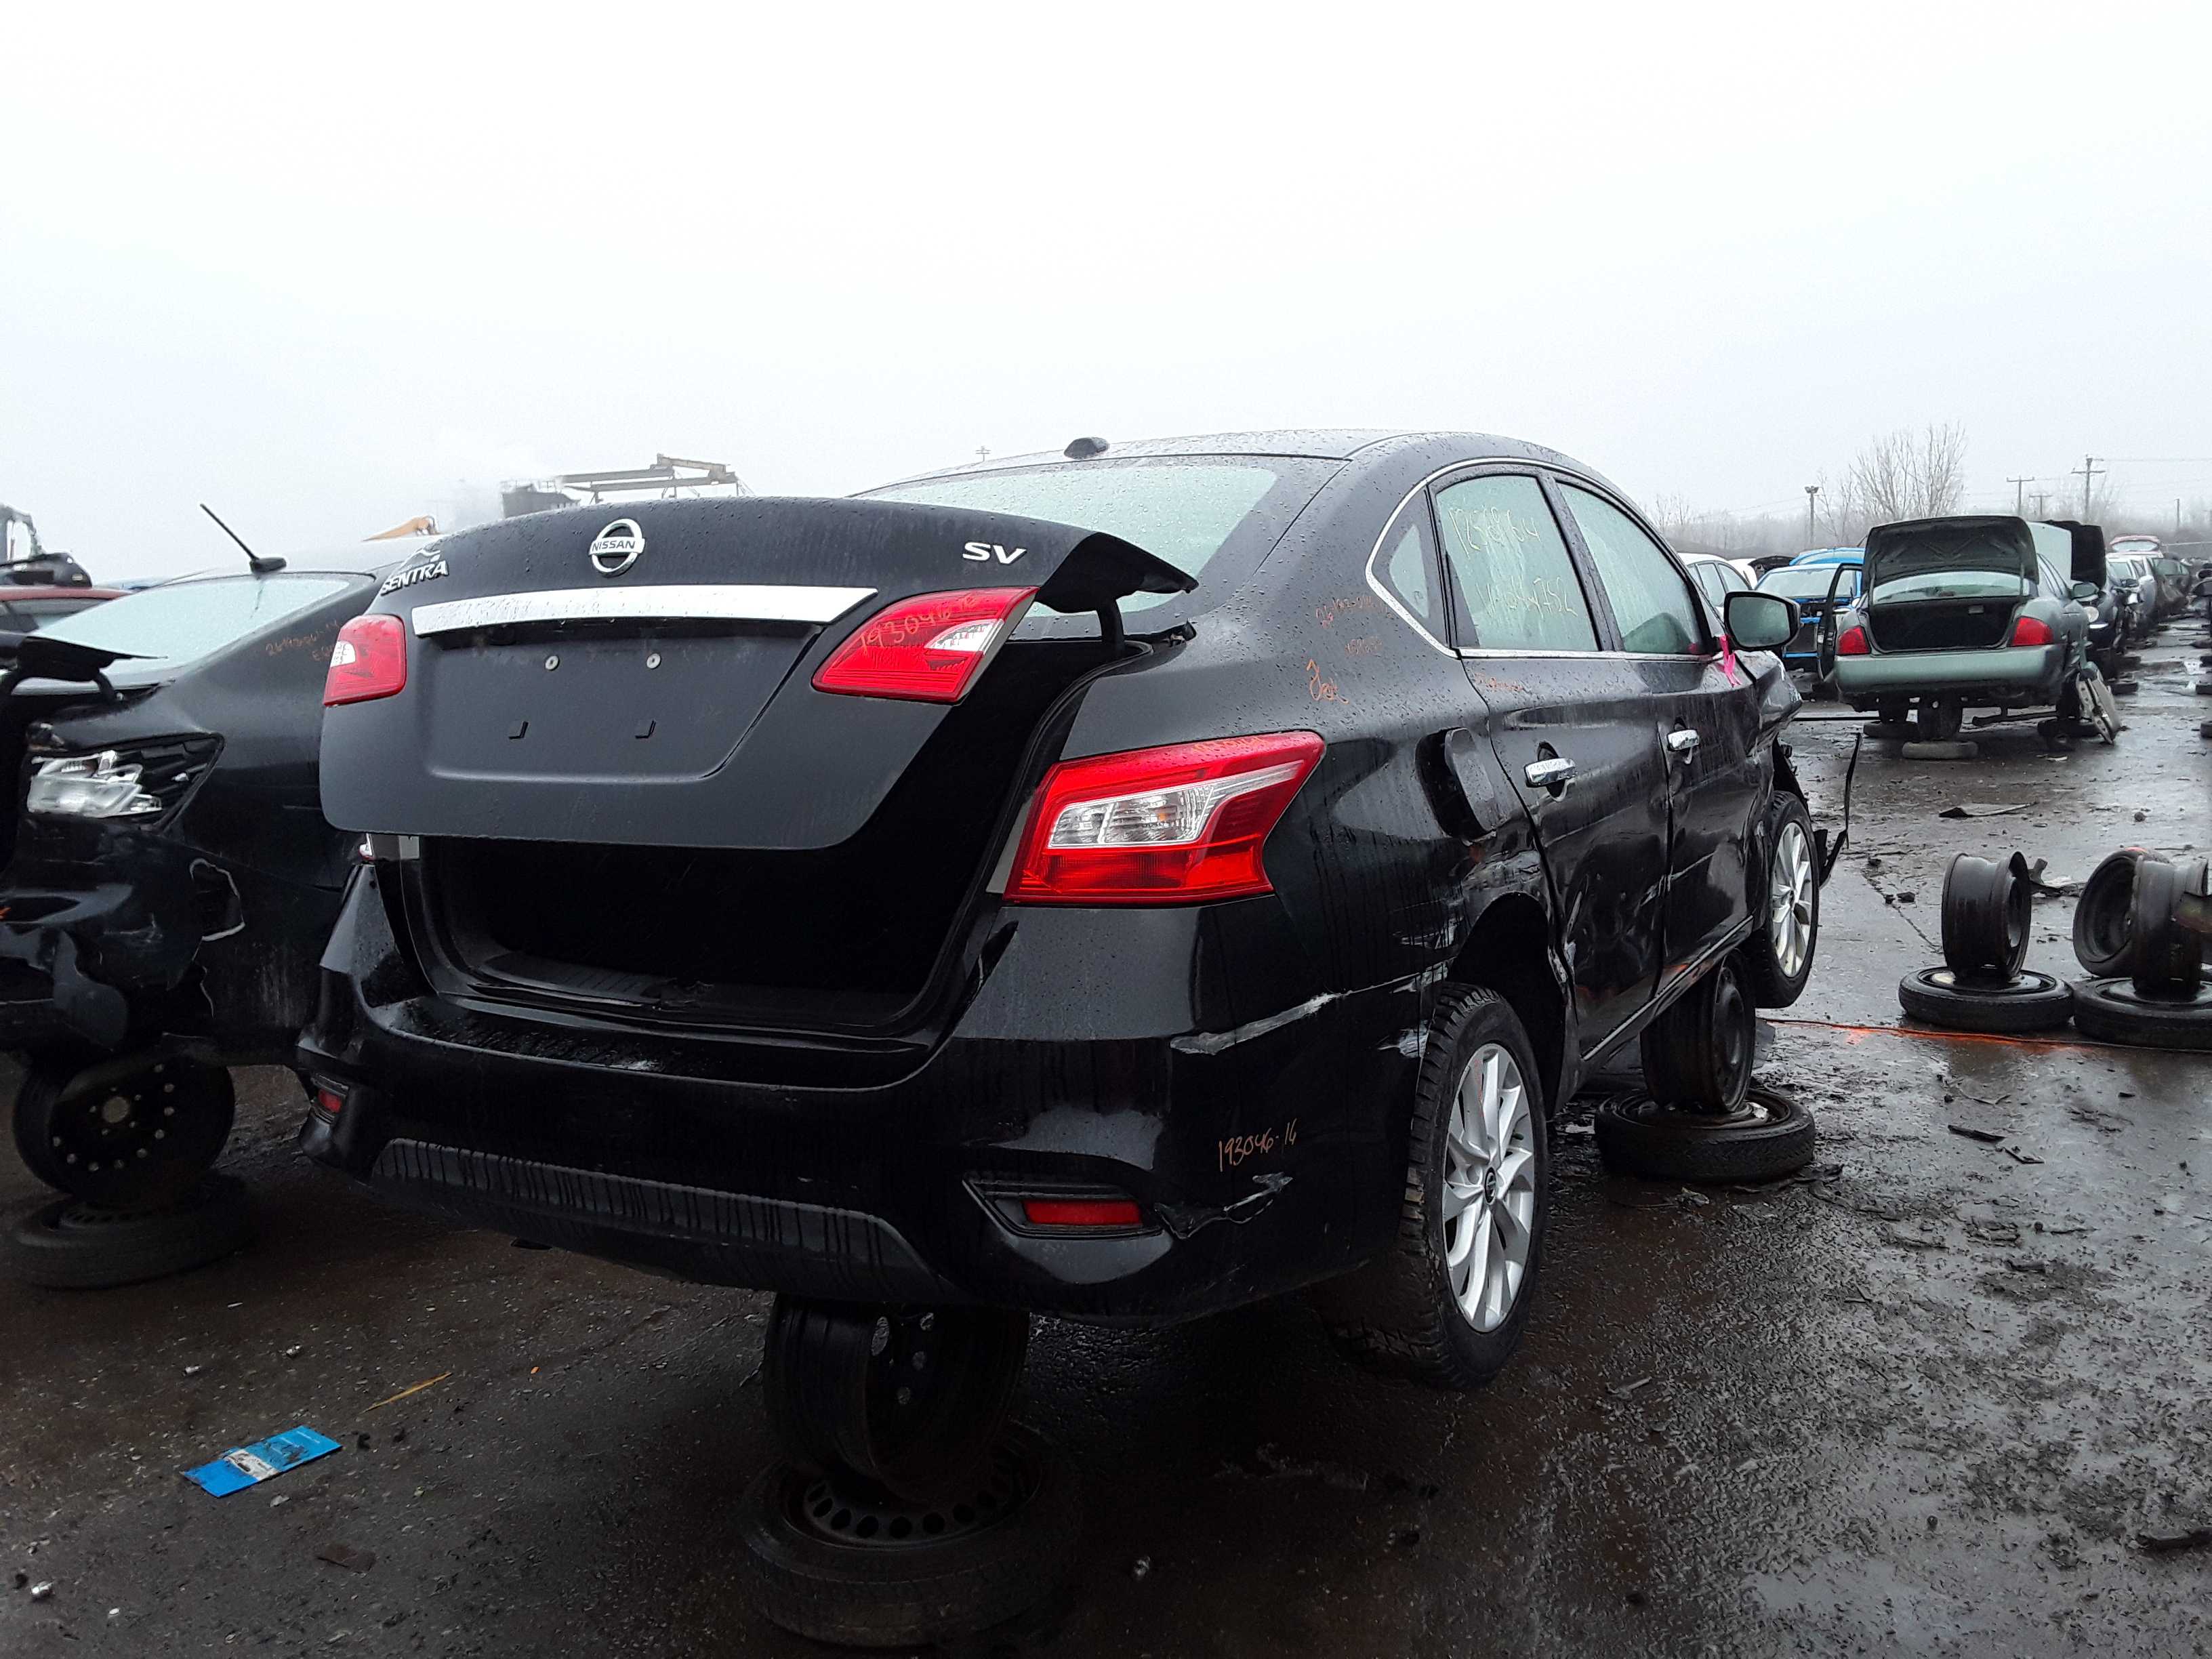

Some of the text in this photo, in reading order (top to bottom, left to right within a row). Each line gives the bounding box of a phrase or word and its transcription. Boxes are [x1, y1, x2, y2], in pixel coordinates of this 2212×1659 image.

[592, 539, 636, 552] NISSAN
[962, 541, 1027, 565] SV
[380, 560, 449, 596] SENTRA
